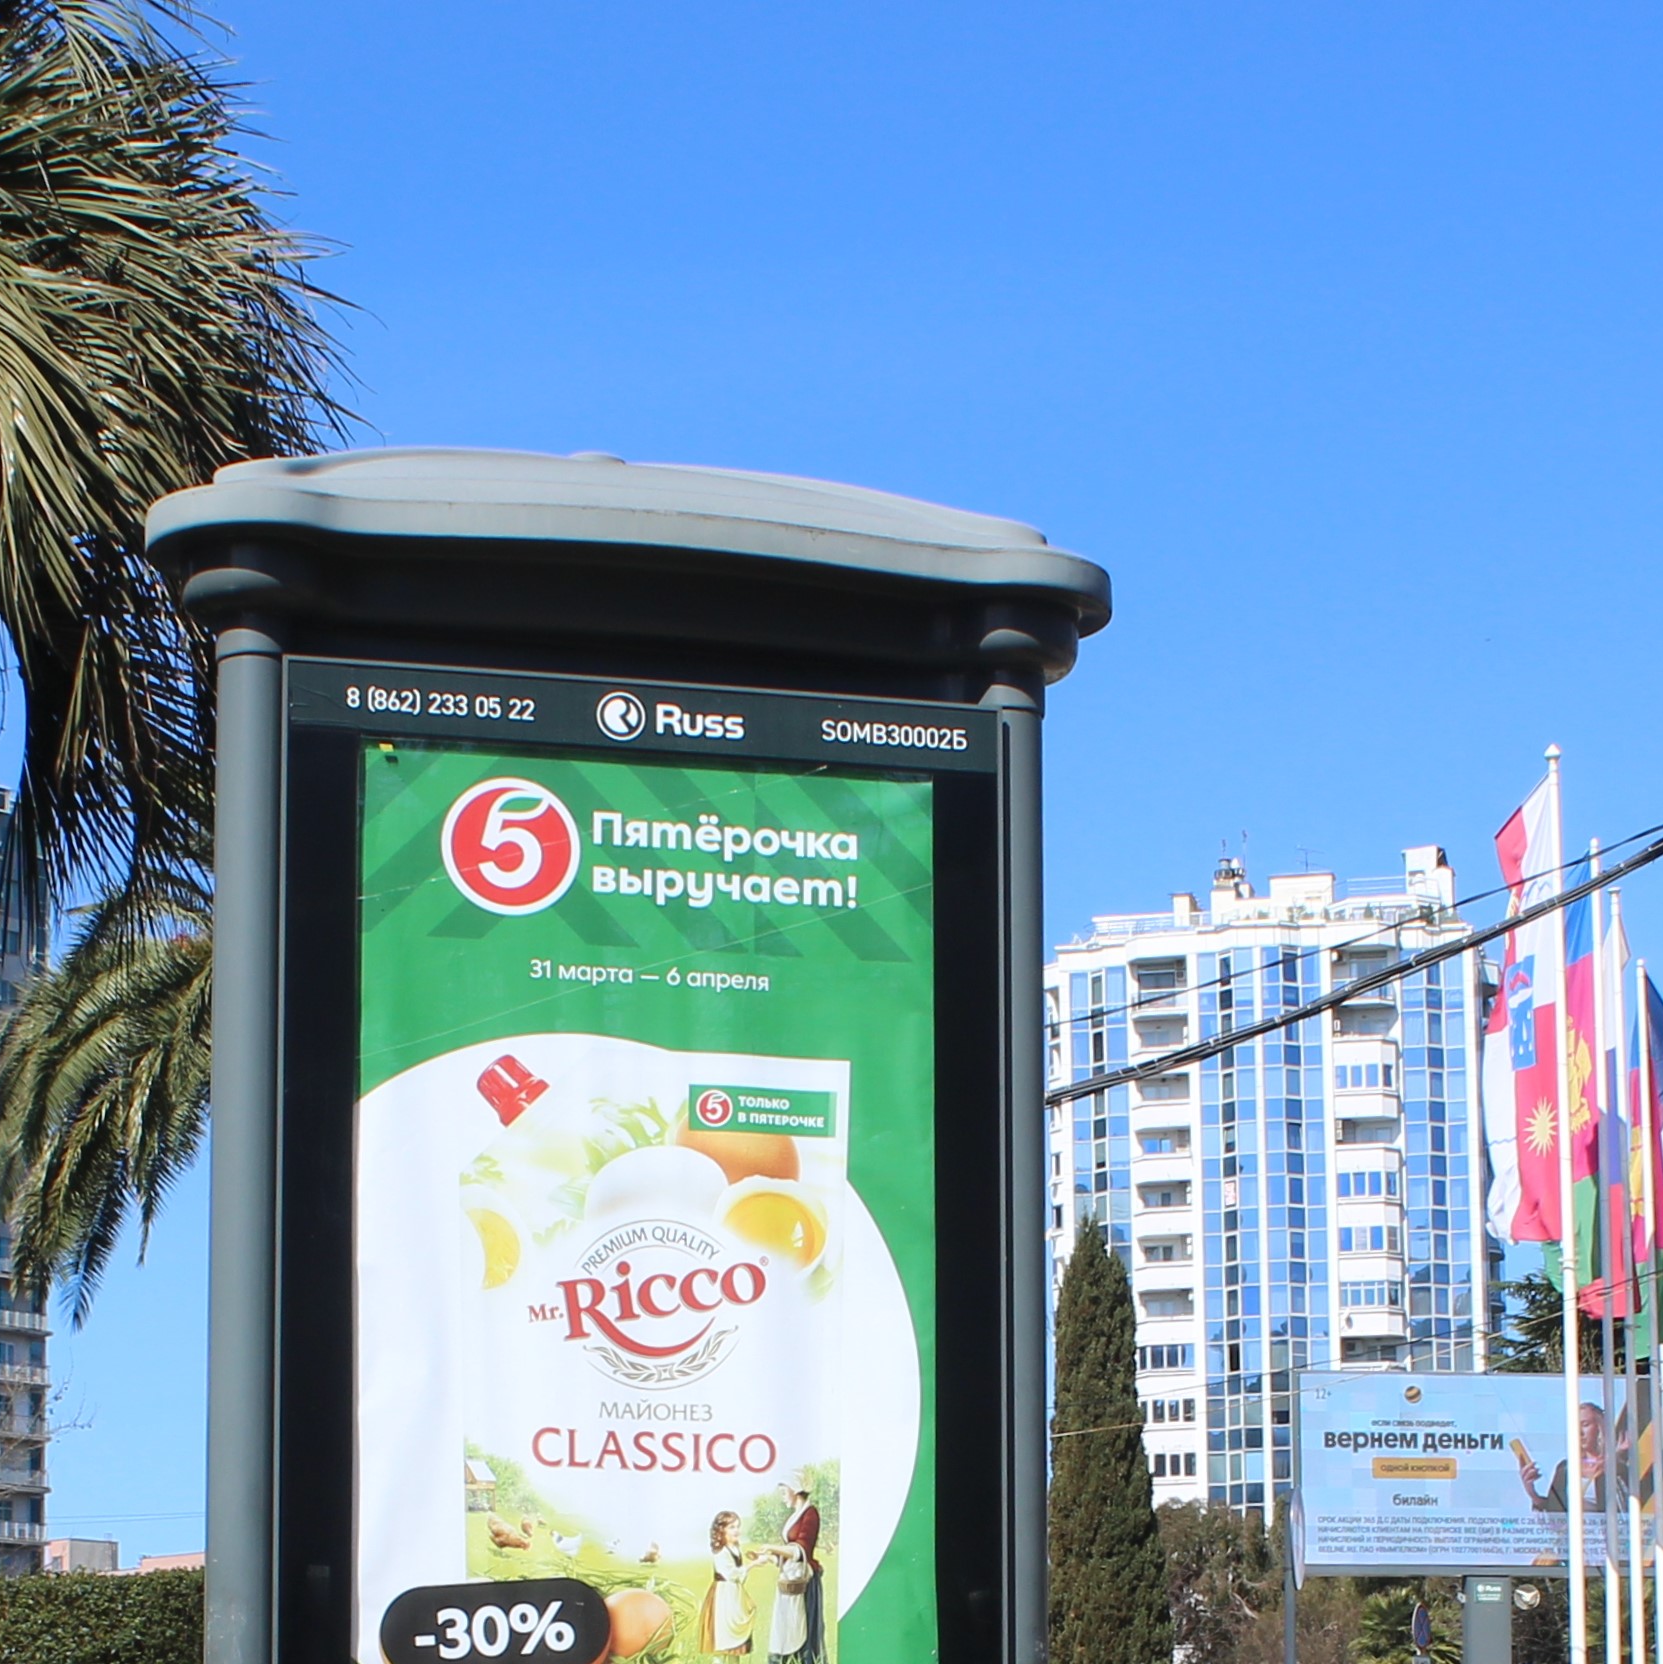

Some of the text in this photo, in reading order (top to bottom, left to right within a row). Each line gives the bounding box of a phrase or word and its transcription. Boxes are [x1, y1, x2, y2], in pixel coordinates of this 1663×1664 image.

[346, 685, 535, 721] 8 (862) 233 05 22
[655, 703, 745, 740] Russ
[591, 810, 859, 862] Пятёрочка
[591, 865, 858, 909] выручает!
[529, 959, 552, 980] 31
[558, 964, 634, 987] марта
[666, 967, 680, 986] 6
[686, 971, 770, 991] апреля
[737, 1095, 790, 1111] ТОЛЬКО
[737, 1112, 825, 1128] В ПЯТЕРОЧКЕ
[581, 1225, 721, 1276] PREMIUM QUALITY
[527, 1261, 767, 1359] Mr. Ricco
[598, 1399, 714, 1422] МАЙОНЕЗ
[531, 1426, 777, 1474] CLASSICO
[1323, 1431, 1504, 1453] вернем деньги
[1380, 1463, 1410, 1473] одной
[1392, 1493, 1439, 1507] билайн
[414, 1600, 576, 1660] -30%
